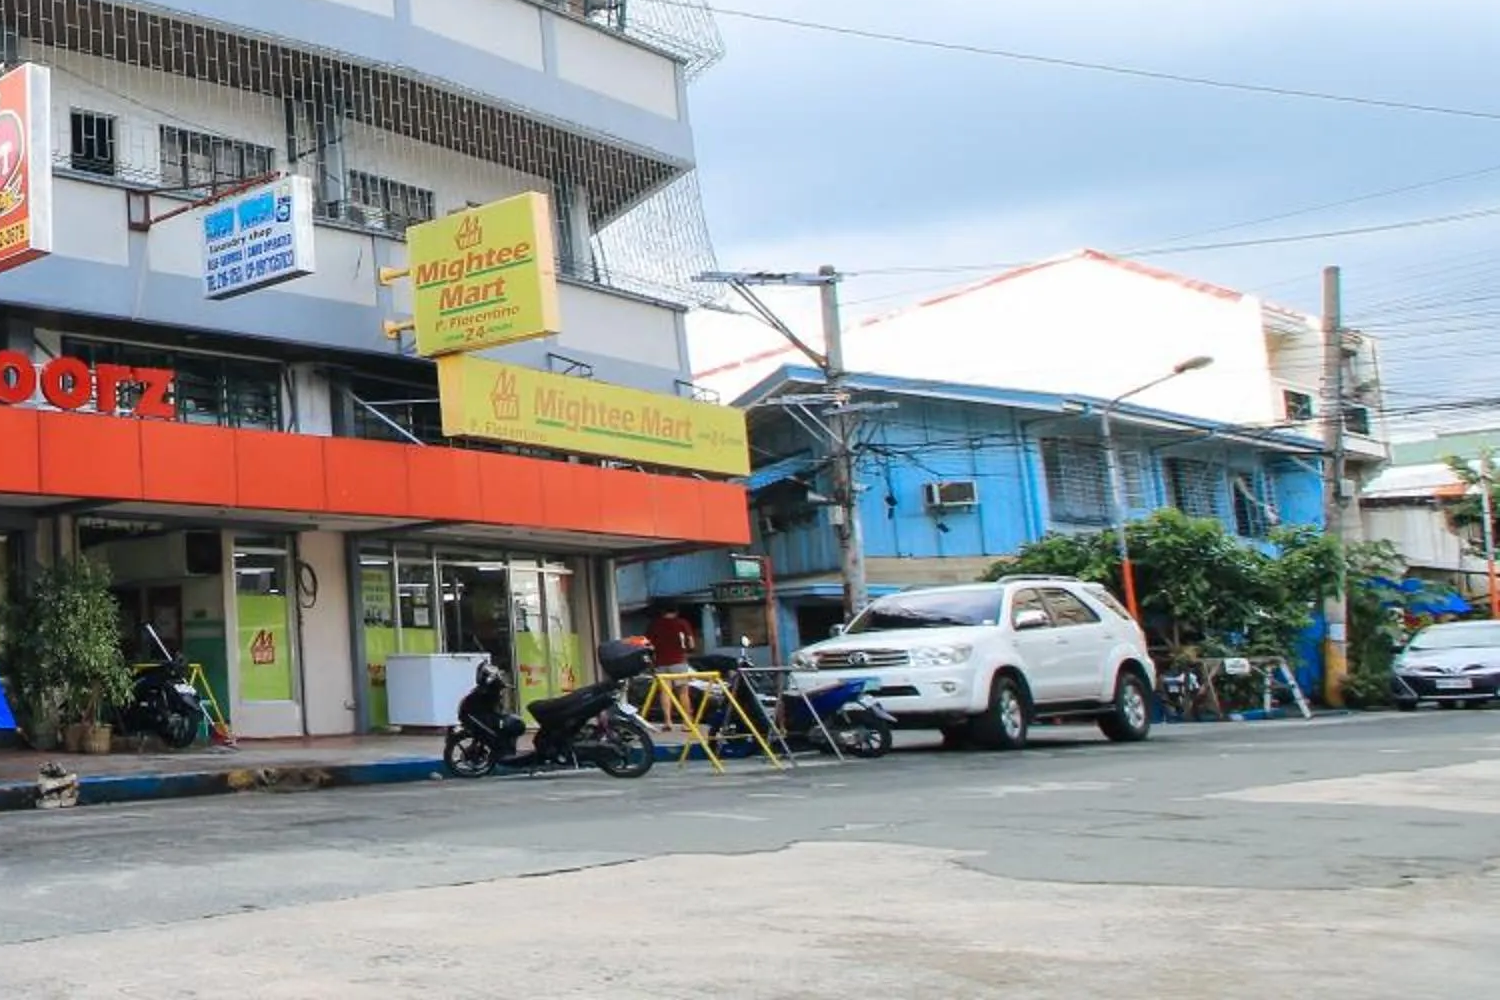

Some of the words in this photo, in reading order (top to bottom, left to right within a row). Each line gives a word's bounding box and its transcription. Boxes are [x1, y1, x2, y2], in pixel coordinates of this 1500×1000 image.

[416, 240, 531, 285] Mightee
[439, 275, 506, 311] Mart
[465, 325, 487, 342] 24
[533, 387, 635, 432] Mightee
[639, 406, 693, 442] Mart
